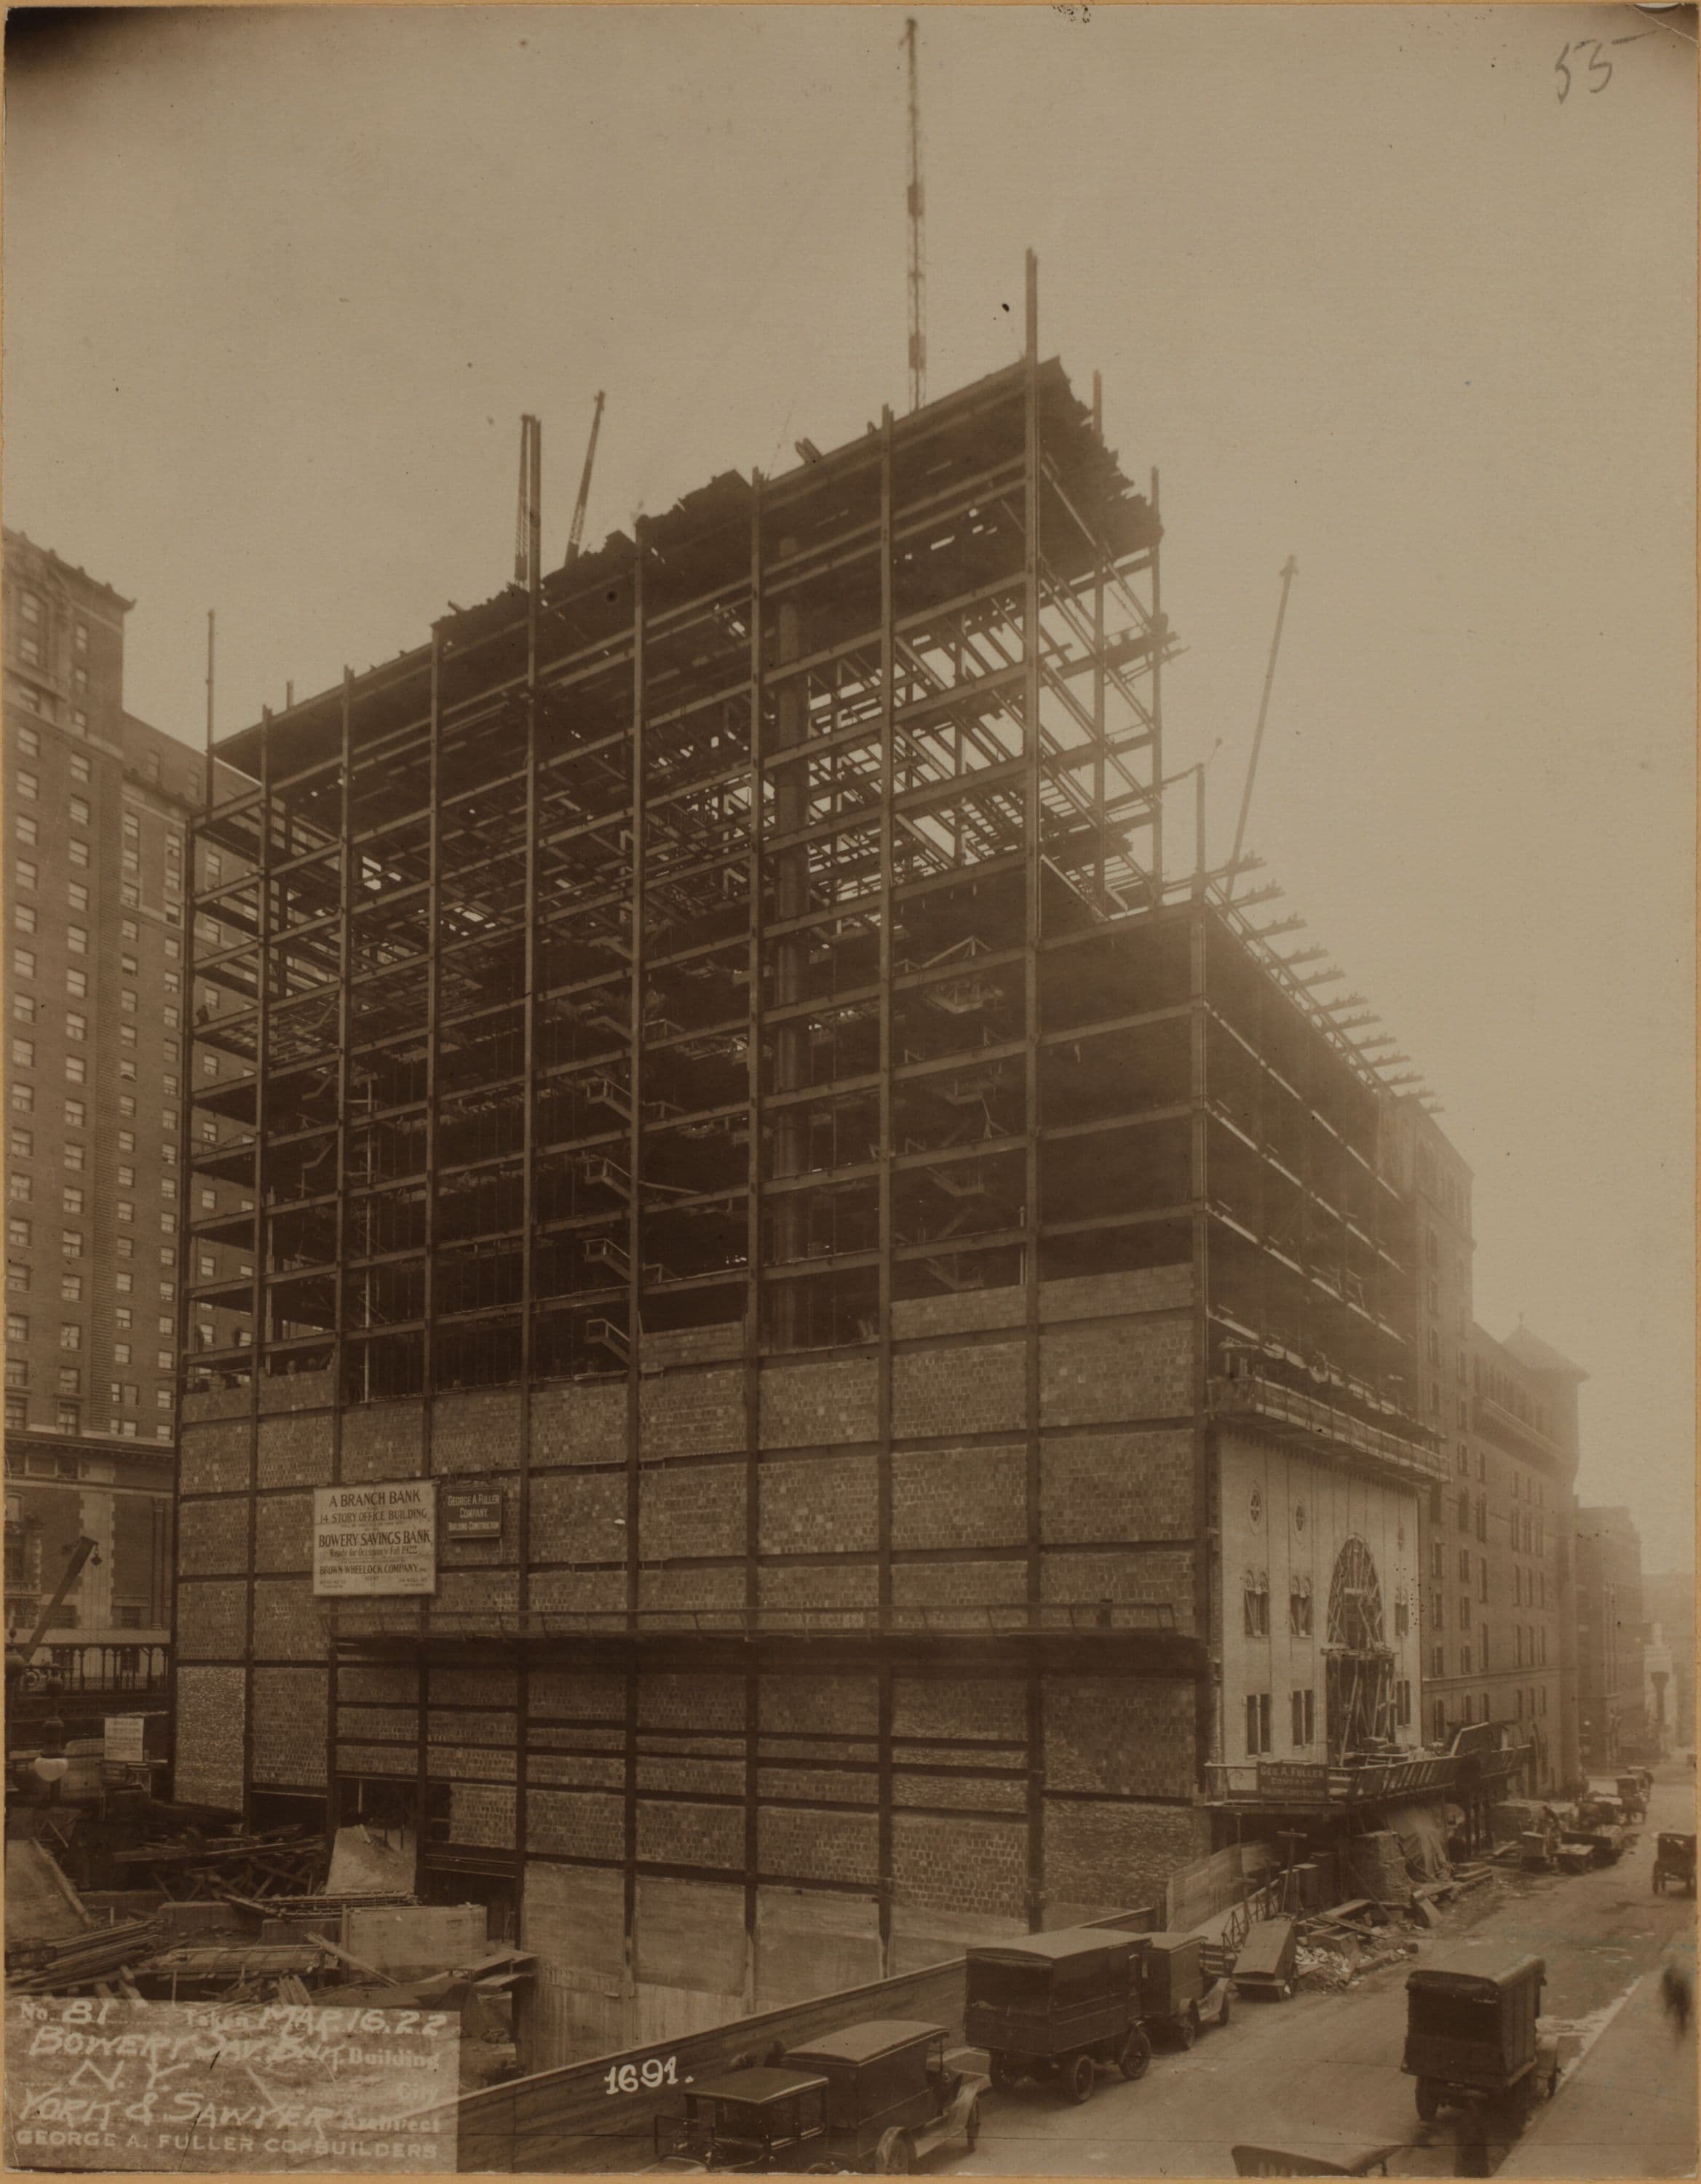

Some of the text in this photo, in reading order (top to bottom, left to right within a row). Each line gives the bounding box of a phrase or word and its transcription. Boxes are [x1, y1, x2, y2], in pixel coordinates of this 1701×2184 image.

[329, 1489, 421, 1508] A BRANCH BANK
[448, 1495, 471, 1506] GEORGE
[478, 1493, 500, 1505] FULLER
[320, 1514, 329, 1524] 14
[331, 1512, 357, 1524] STORY
[358, 1510, 385, 1522] OFFICE
[389, 1508, 427, 1520] BUILDING
[319, 1529, 431, 1548] BOWERY SAVINGS BANK
[1291, 1767, 1324, 1778] FULLER
